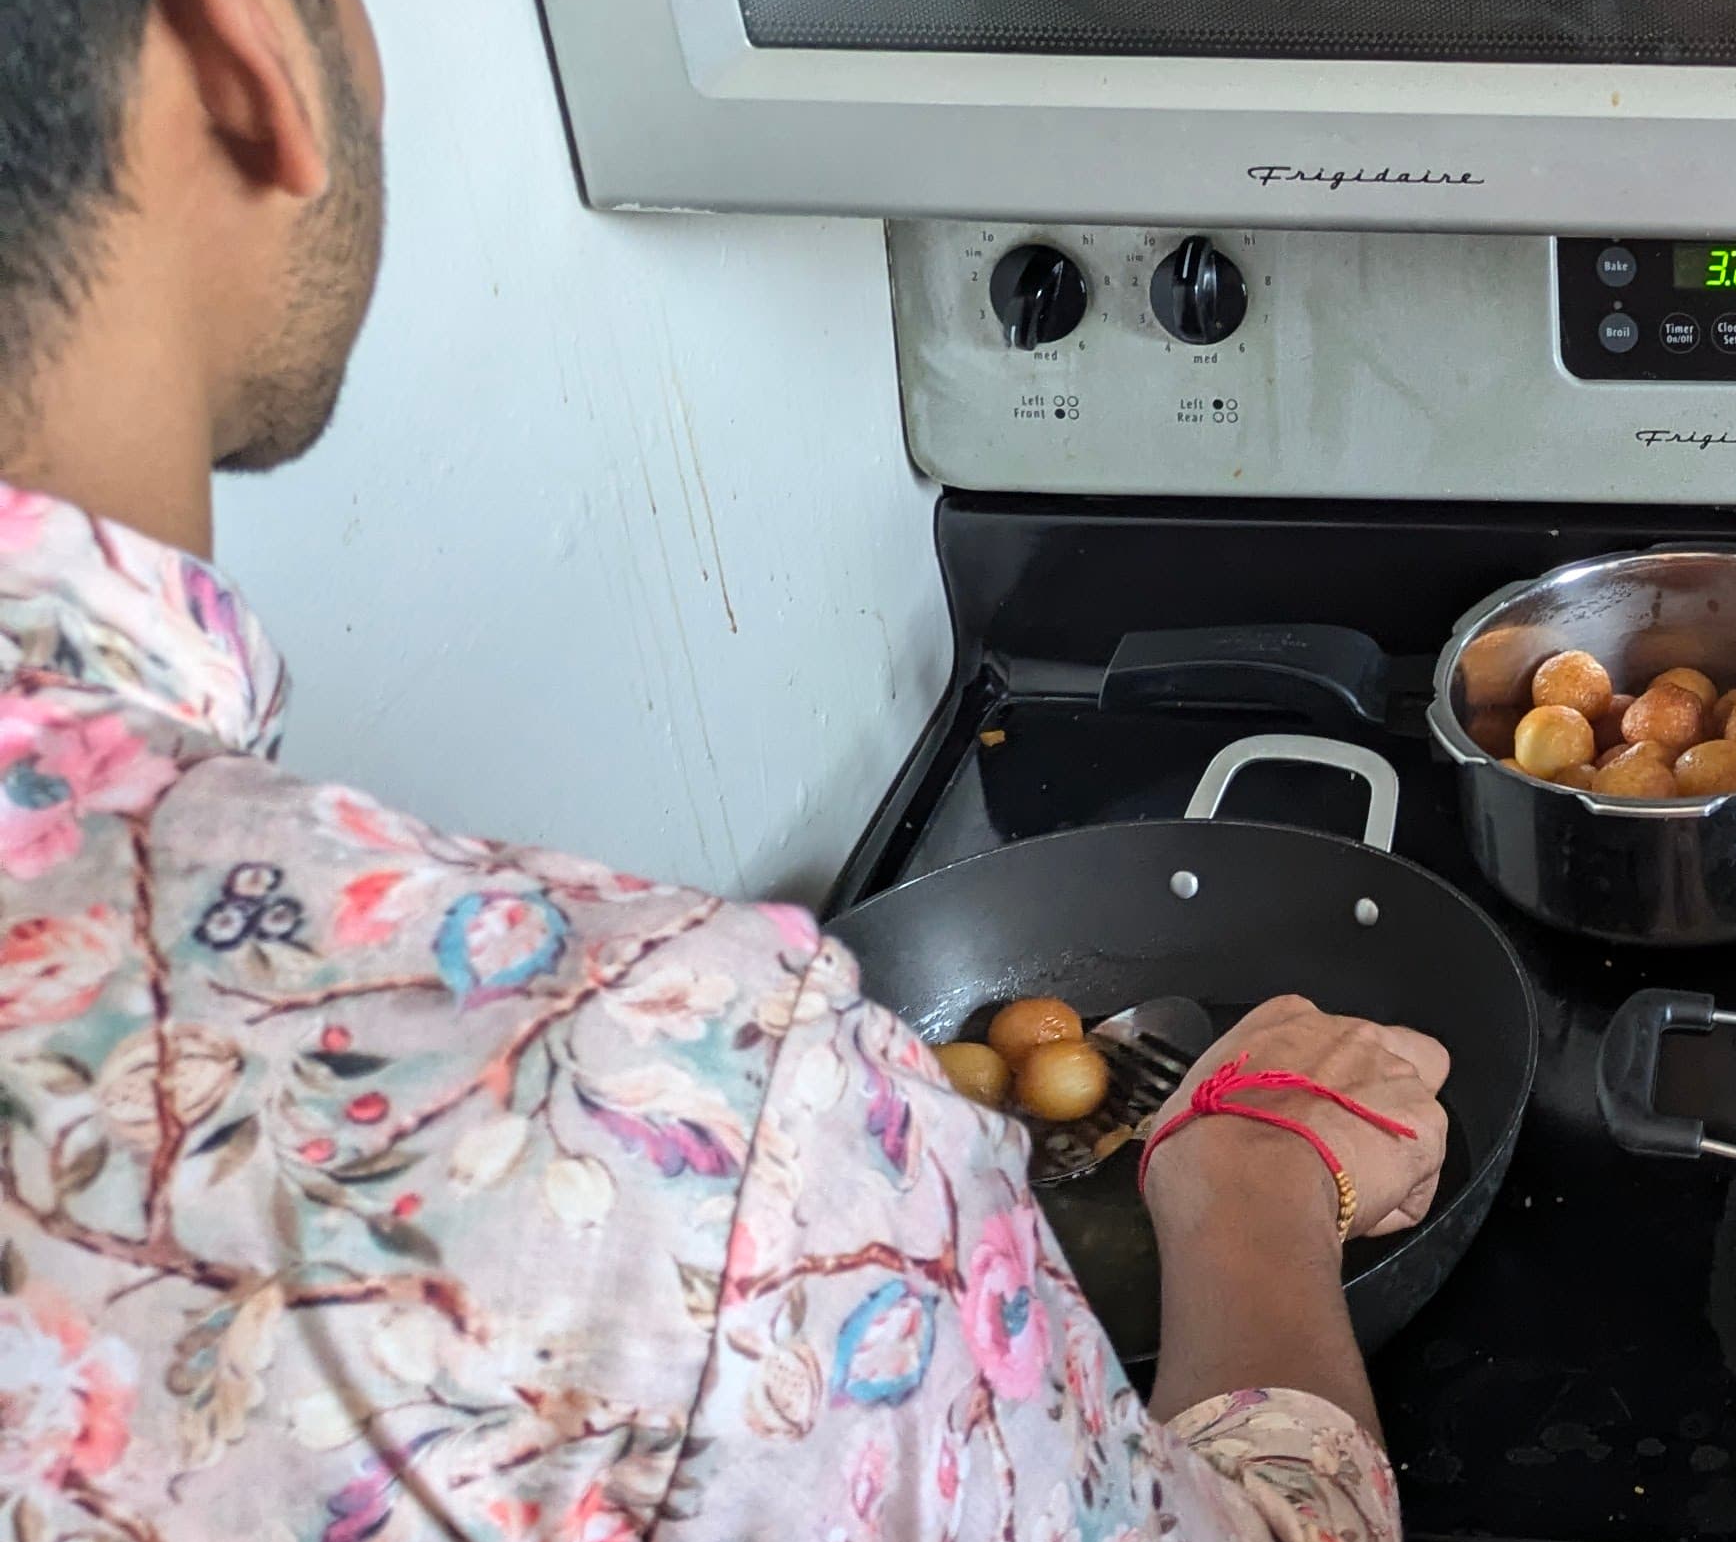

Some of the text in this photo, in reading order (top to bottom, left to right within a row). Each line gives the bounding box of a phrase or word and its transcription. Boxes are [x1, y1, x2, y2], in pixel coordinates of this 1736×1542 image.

[1248, 166, 1485, 190] Frigidaire
[982, 231, 994, 242] lo
[1083, 234, 1094, 245] hi
[1144, 235, 1156, 246] lo
[1244, 235, 1256, 246] hi
[966, 249, 982, 257] sim
[1126, 254, 1144, 262] sim
[1604, 261, 1628, 271] Bake
[972, 272, 978, 281] 2
[1104, 276, 1111, 286] 8
[1265, 276, 1272, 286] 8
[1132, 277, 1139, 287] 2
[980, 310, 986, 320] 3
[1102, 313, 1109, 323] 7
[1139, 314, 1146, 324] 3
[1263, 315, 1269, 324] 7
[1606, 327, 1630, 337] Broil
[1665, 323, 1694, 334] Timer
[1666, 334, 1693, 344] On/Off
[1079, 341, 1085, 351] 6
[1165, 343, 1171, 352] 4
[1239, 343, 1246, 353] 6
[1034, 351, 1058, 360] med
[1193, 353, 1218, 364] med
[1022, 396, 1045, 406] Left
[1180, 399, 1204, 410] Left
[1014, 409, 1046, 419] Front
[1177, 412, 1204, 422] Rear
